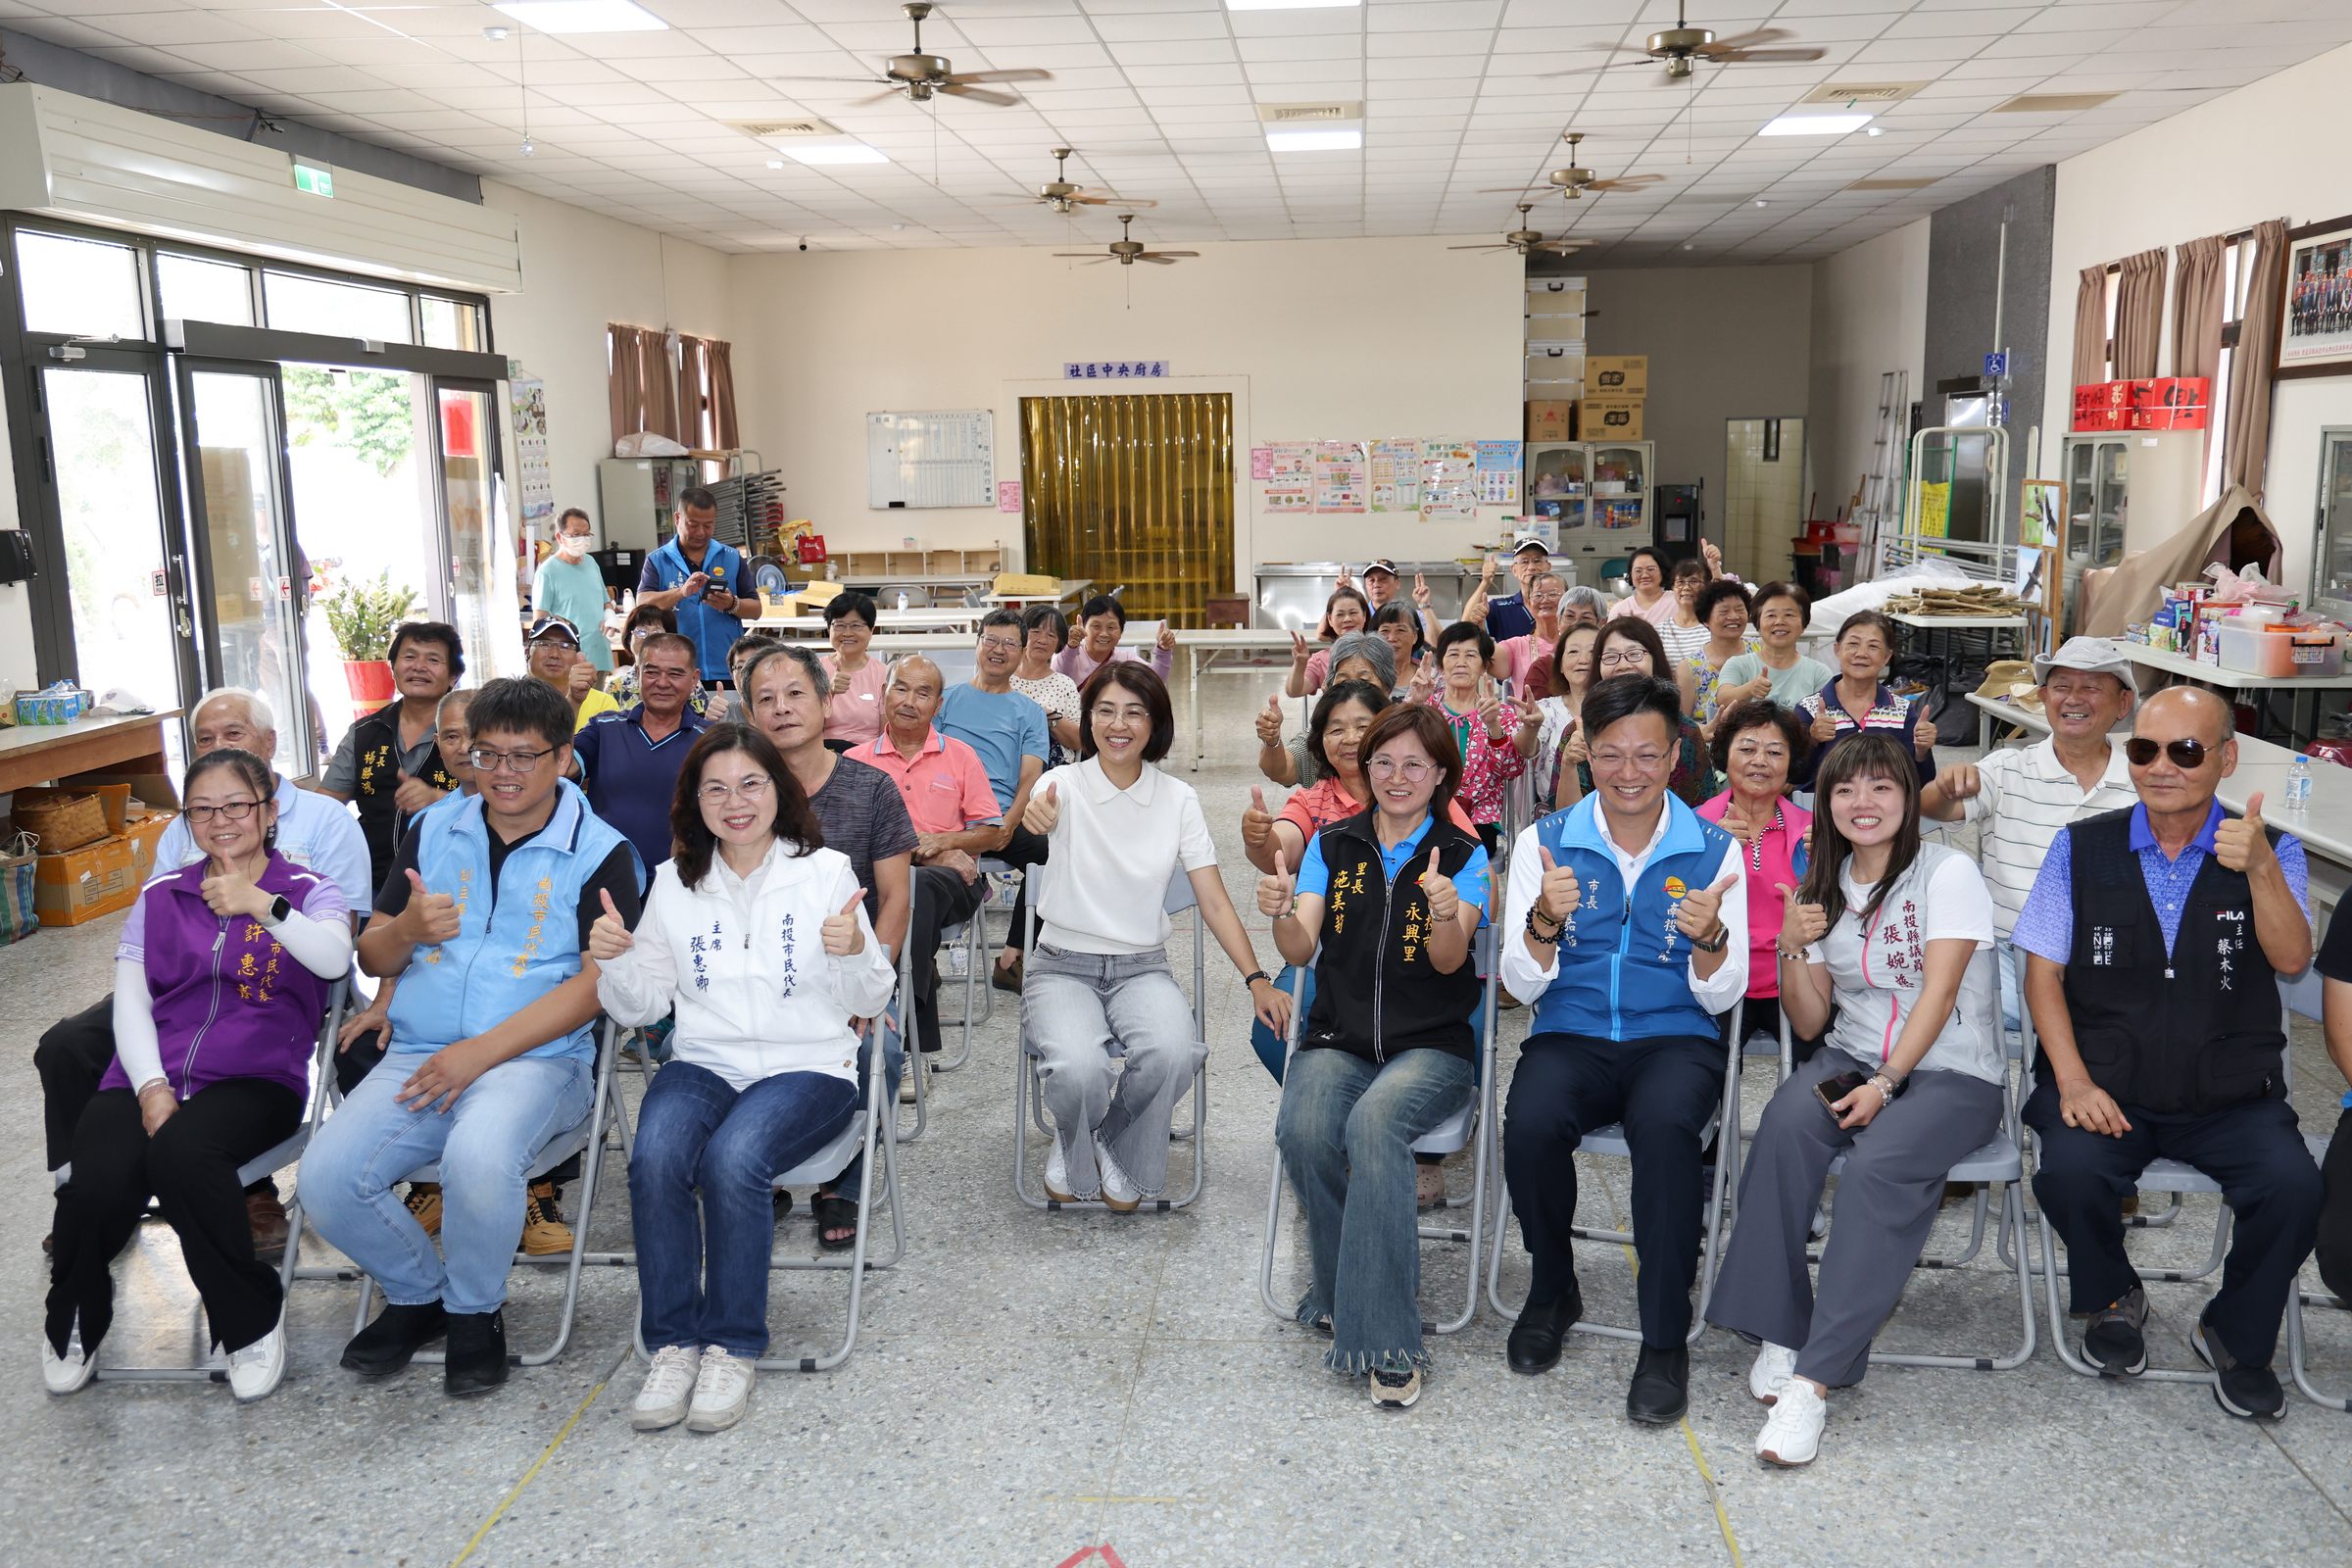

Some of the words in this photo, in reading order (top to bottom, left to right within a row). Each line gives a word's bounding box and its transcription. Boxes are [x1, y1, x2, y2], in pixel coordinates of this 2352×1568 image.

[1069, 362, 1163, 378] 社區中央廚房
[155, 573, 164, 586] 拉
[376, 745, 389, 767] 里長
[433, 770, 446, 792] 福
[1350, 861, 1367, 895] 里長
[1586, 878, 1599, 909] 市長
[2213, 910, 2245, 920] FILA
[710, 920, 722, 952] 主席
[1402, 902, 1422, 961] 永興里
[1902, 900, 1924, 972] 南投縣議員
[2093, 936, 2102, 946] N
[2234, 923, 2244, 950] 主任
[257, 942, 283, 1001] 市民代表
[691, 935, 710, 993] 張惠卿
[2104, 955, 2112, 965] E
[2217, 938, 2233, 991] 蔡木火
